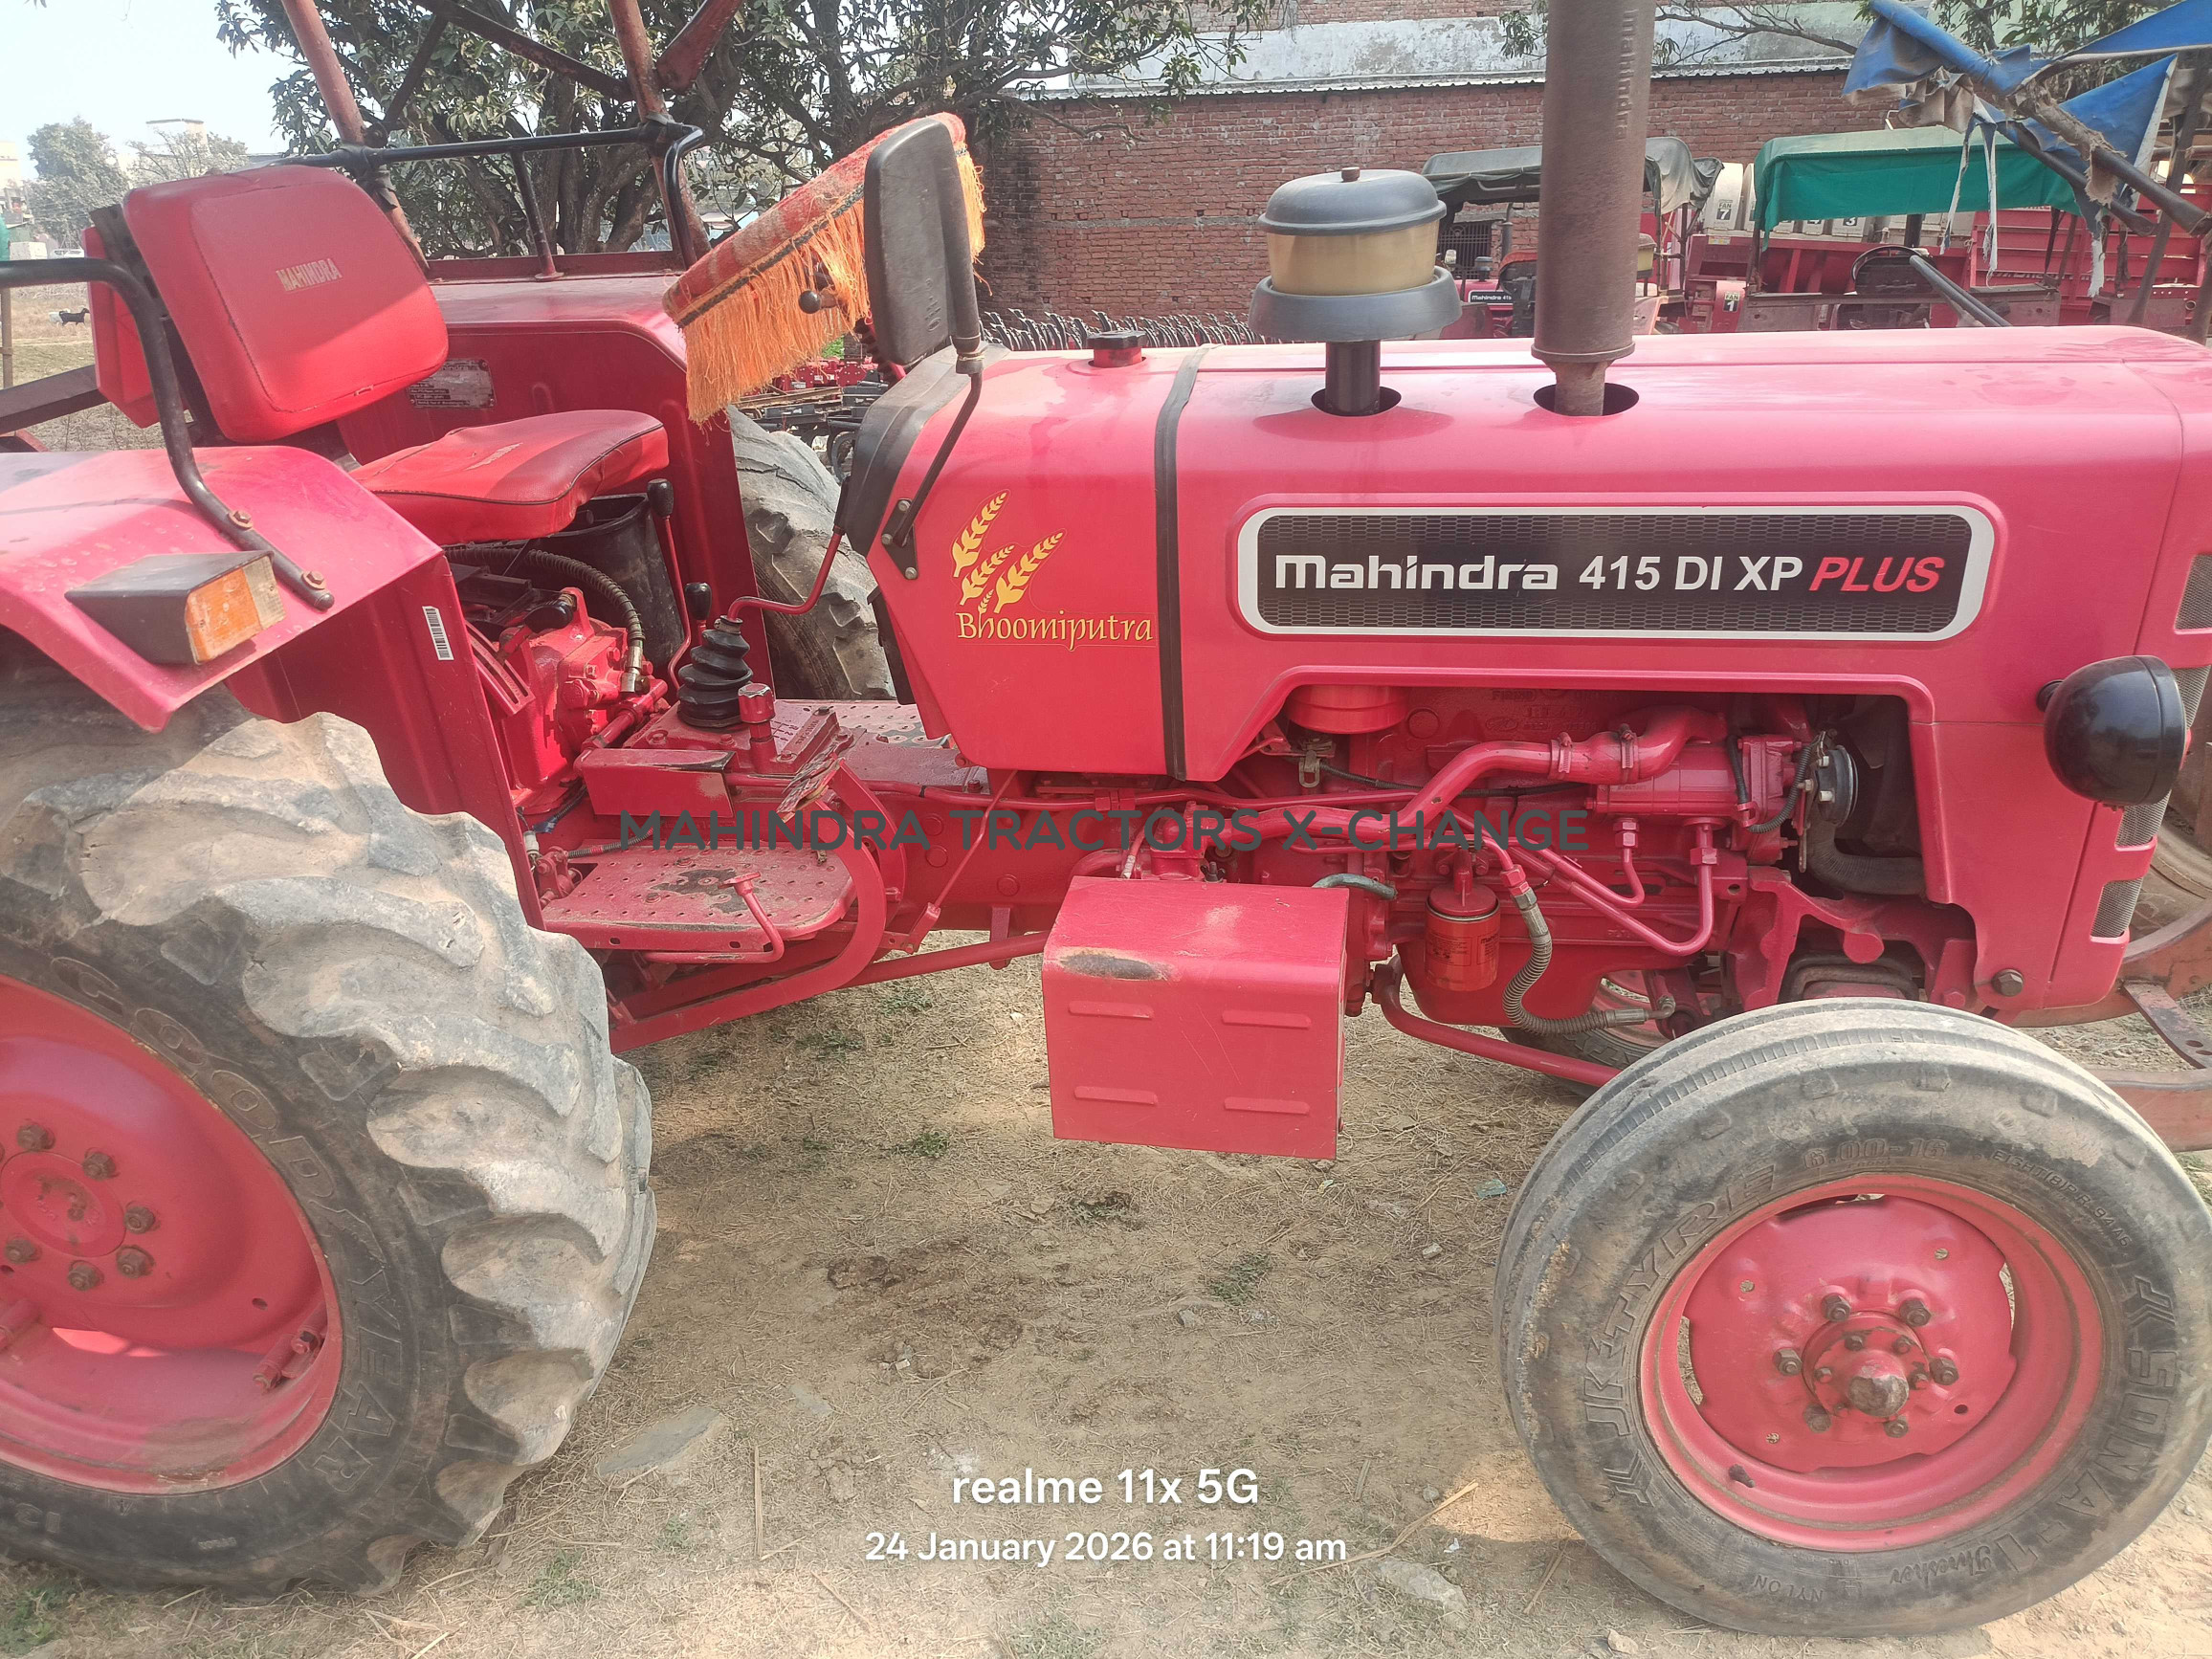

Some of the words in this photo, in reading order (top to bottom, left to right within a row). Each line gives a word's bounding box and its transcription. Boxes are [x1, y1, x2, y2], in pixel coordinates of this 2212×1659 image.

[1719, 209, 1730, 220] 7
[276, 258, 343, 292] MAHINDRA
[1727, 300, 1736, 312] 1
[1579, 555, 1661, 590] 415
[1674, 556, 1723, 591] DI
[1733, 556, 1803, 591] XP
[1808, 557, 1945, 592] PLUS
[955, 609, 1154, 651] Bhoomiputra
[1803, 1138, 1948, 1170] 6.00-16
[1753, 1572, 1825, 1603] NYLON
